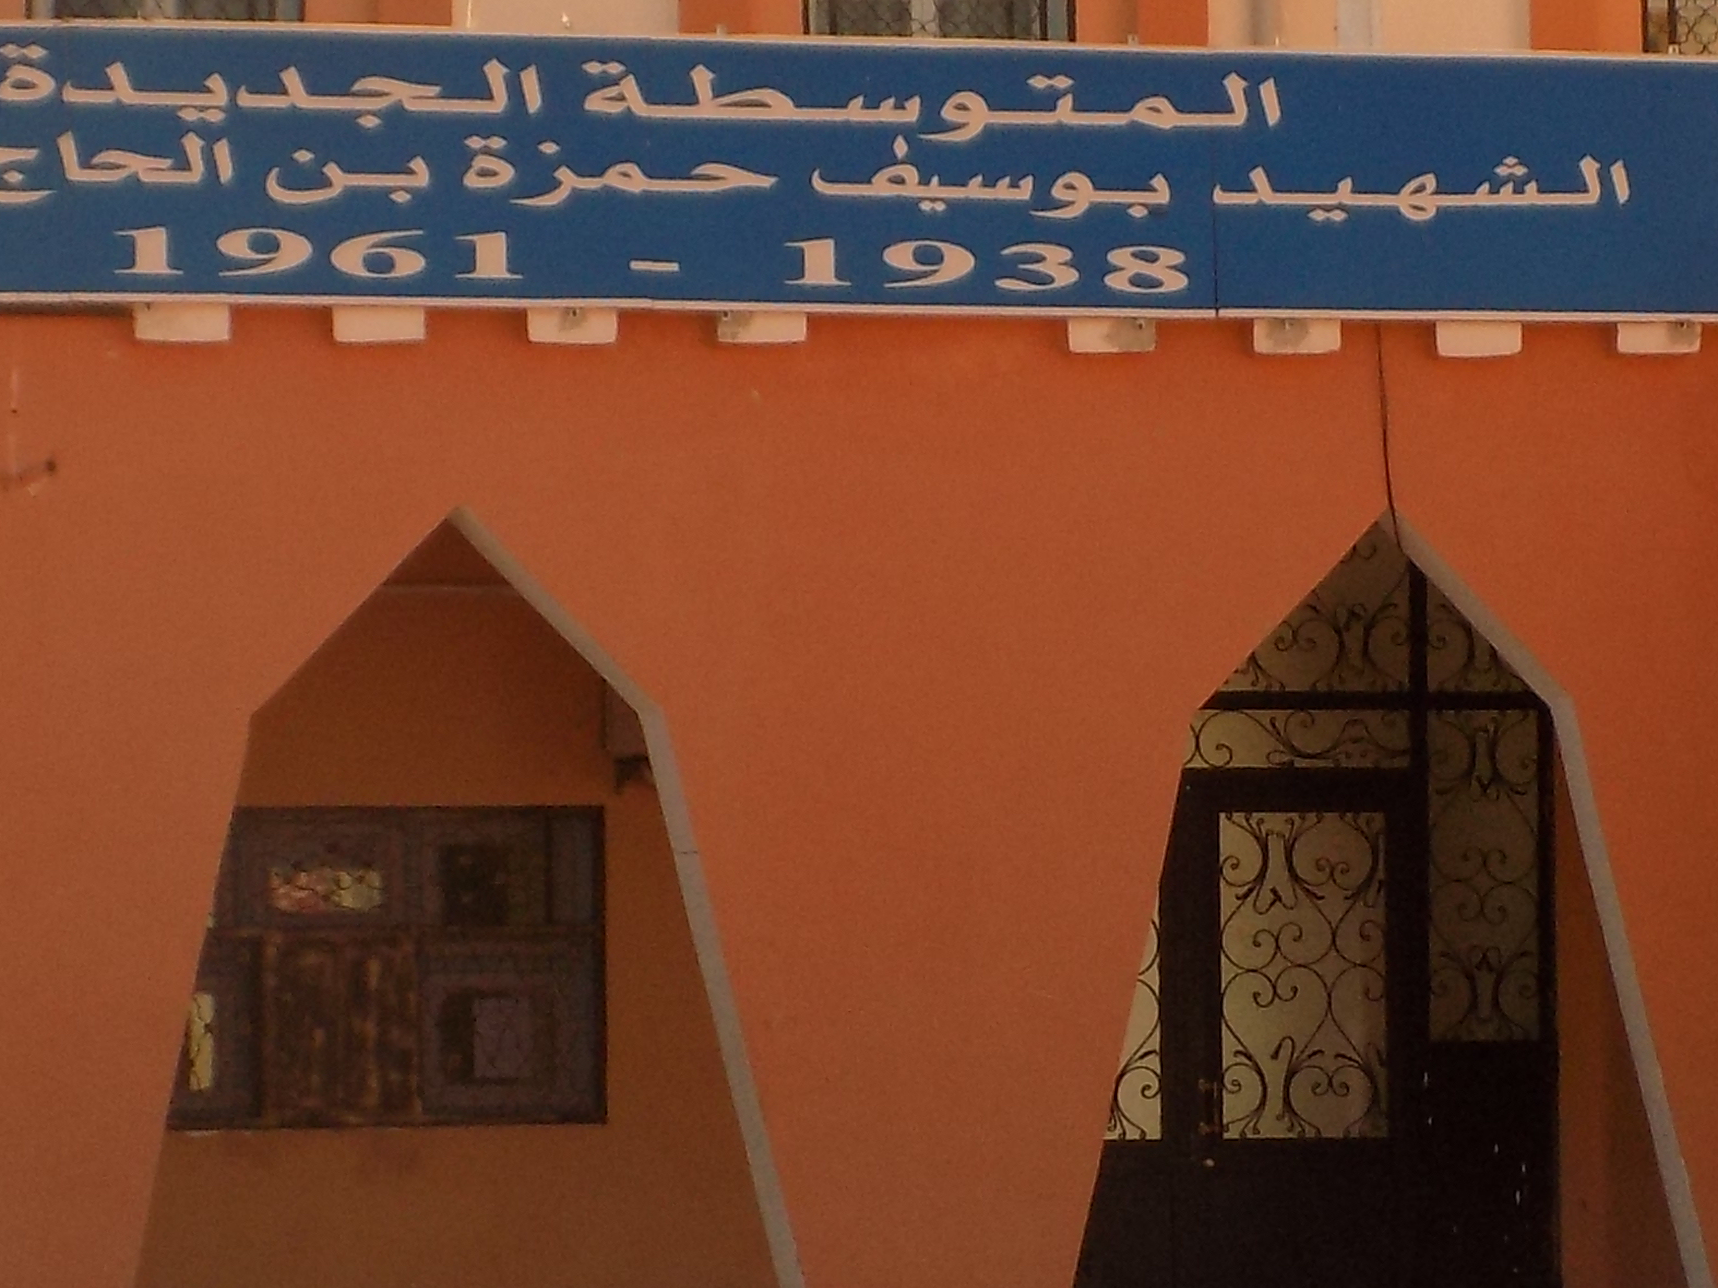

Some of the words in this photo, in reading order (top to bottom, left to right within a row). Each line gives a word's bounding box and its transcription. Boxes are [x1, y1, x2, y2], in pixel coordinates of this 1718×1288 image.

[582, 61, 1281, 142] المتوسطة
[266, 149, 430, 205] بن
[463, 136, 777, 207] حمزة
[811, 135, 1170, 219] بوسيف
[1212, 156, 1630, 222] الشهيد
[114, 226, 522, 279] 1961
[630, 259, 679, 272] -
[784, 238, 1190, 293] 1938
